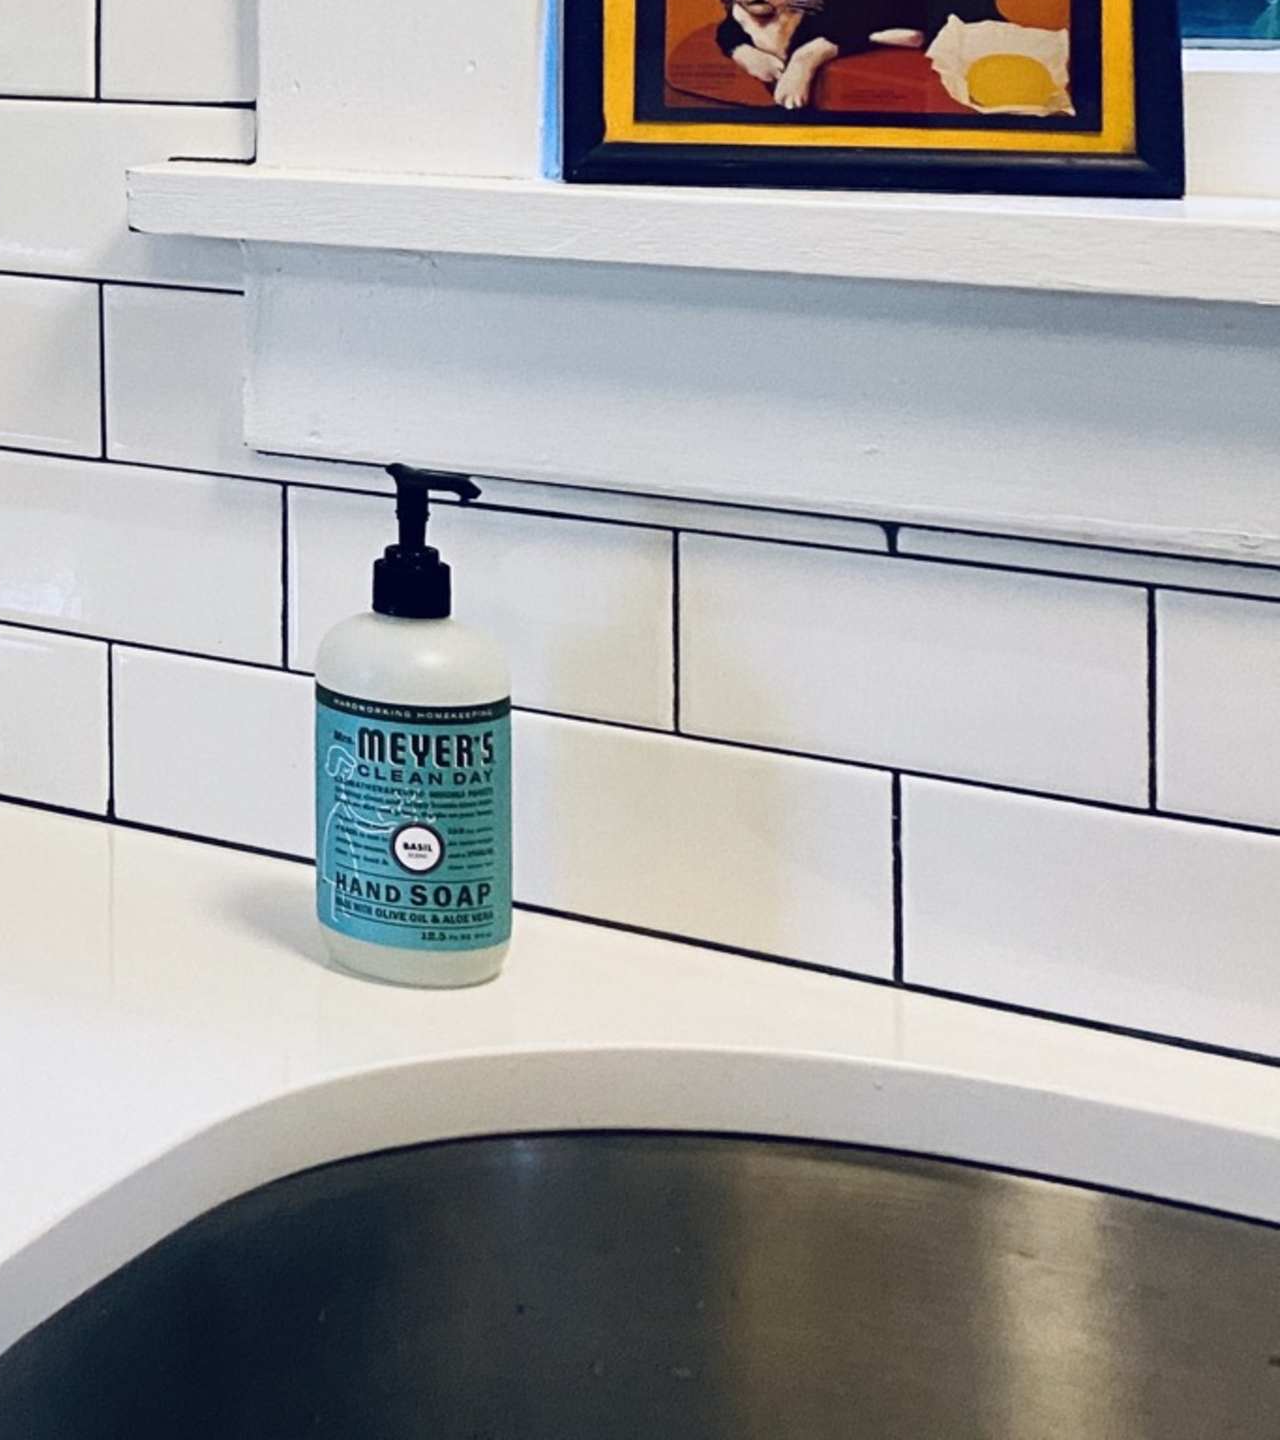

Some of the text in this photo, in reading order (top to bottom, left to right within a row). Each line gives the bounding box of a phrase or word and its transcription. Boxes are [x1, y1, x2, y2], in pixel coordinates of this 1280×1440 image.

[358, 727, 494, 768] MEYER'S
[357, 764, 493, 785] CLEAN DAY
[403, 842, 432, 852] BASIL
[336, 872, 491, 907] HAND SOAP
[375, 907, 406, 922] OLIVE
[410, 913, 428, 924] OIL
[442, 913, 469, 924] ALOE
